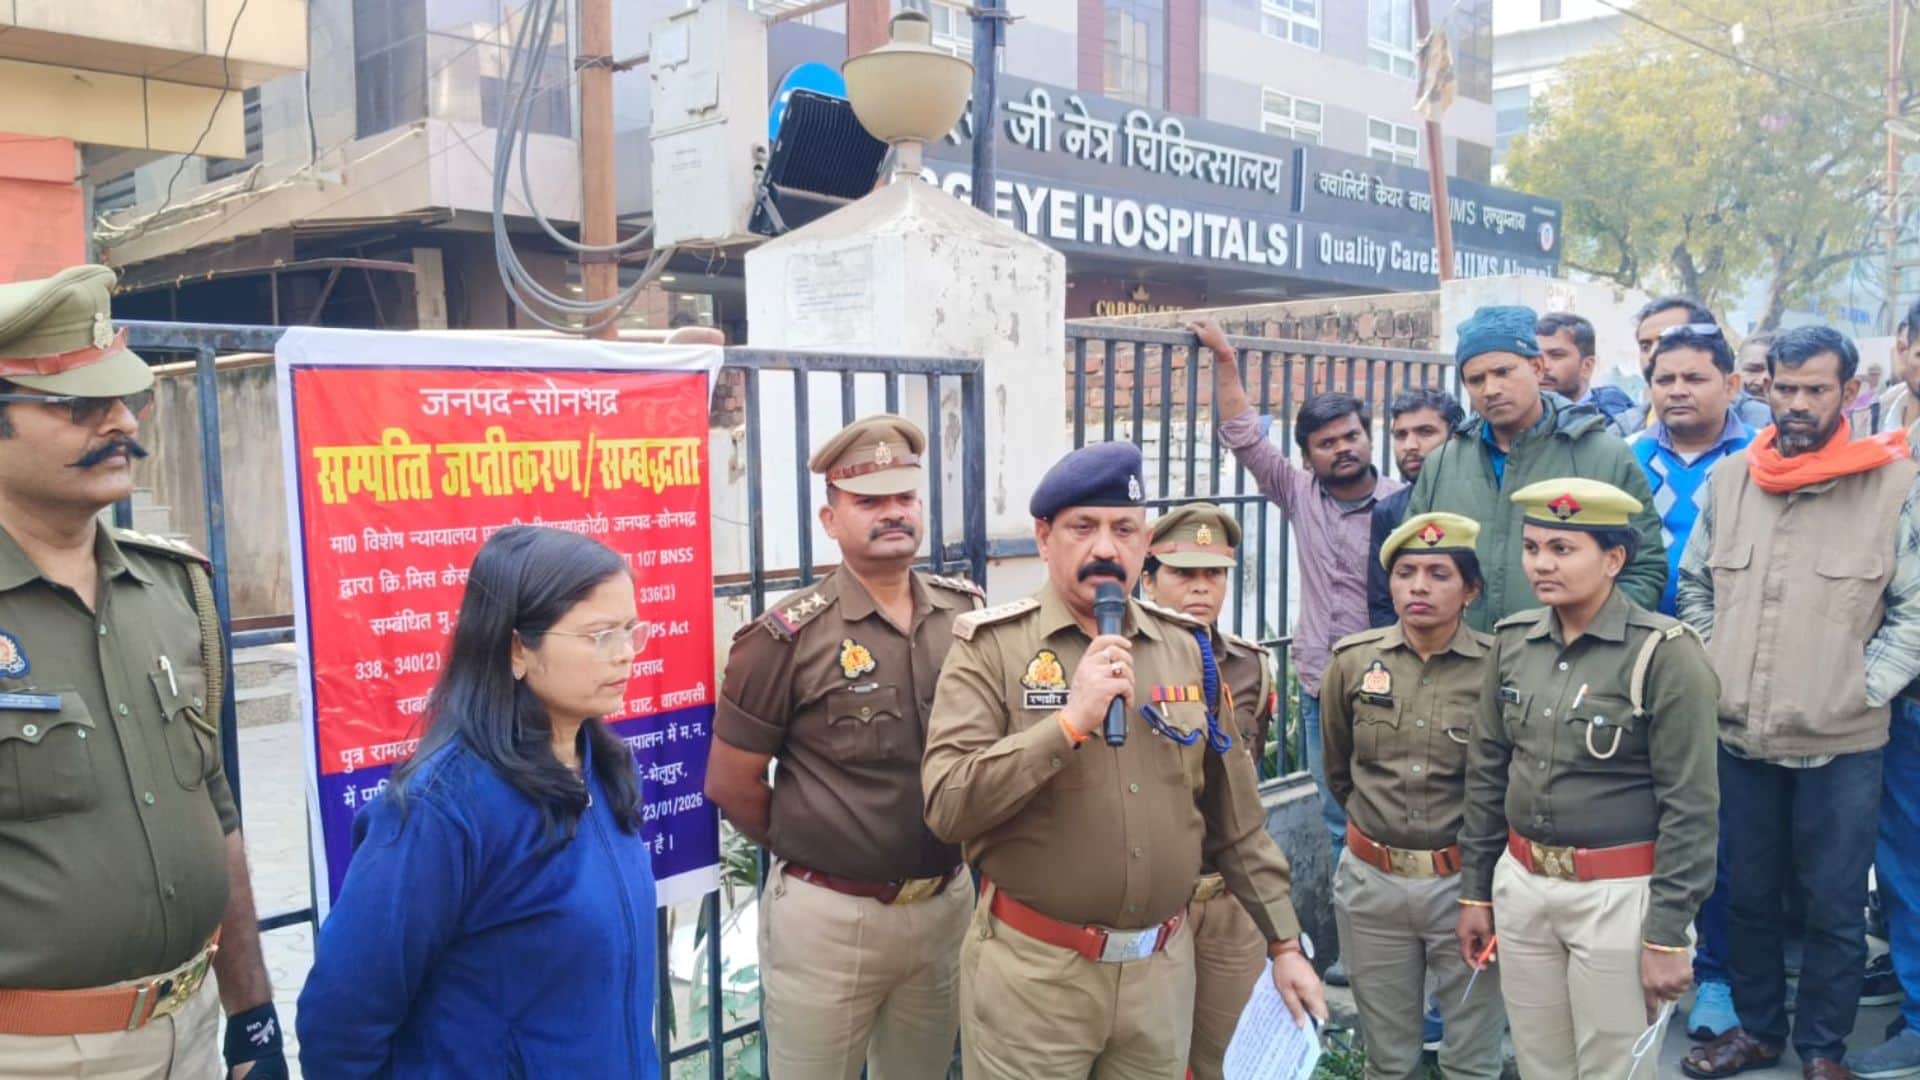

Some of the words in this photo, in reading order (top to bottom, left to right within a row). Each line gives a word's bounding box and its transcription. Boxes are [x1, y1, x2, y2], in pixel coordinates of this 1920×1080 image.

[1008, 88, 1056, 151] जी
[1064, 95, 1118, 163] नेत्र
[1125, 110, 1284, 194] चिकित्सालय
[1376, 176, 1405, 208] केयर
[1083, 193, 1289, 266] HOSPITALS
[1320, 232, 1386, 274] Quality
[1391, 240, 1429, 274] Care
[419, 378, 620, 417] जनपद-सोनभद्र
[312, 426, 433, 505] सम्पत्ति
[362, 526, 405, 552] विशेष
[409, 525, 477, 548] न्यायालय
[613, 508, 697, 532] जनपद-सोनभद्र
[637, 551, 656, 568] 107
[659, 547, 694, 565] BNSS
[339, 576, 374, 599] द्वारा
[639, 583, 676, 604] 336(3)
[368, 608, 431, 636] सम्बंधित
[668, 620, 689, 636] Act
[354, 660, 389, 680] 338,
[394, 652, 441, 676] 340(2)
[667, 722, 678, 742] में
[340, 749, 364, 774] पुत्र
[343, 784, 357, 808] में
[642, 792, 704, 822] 23/01/2026
